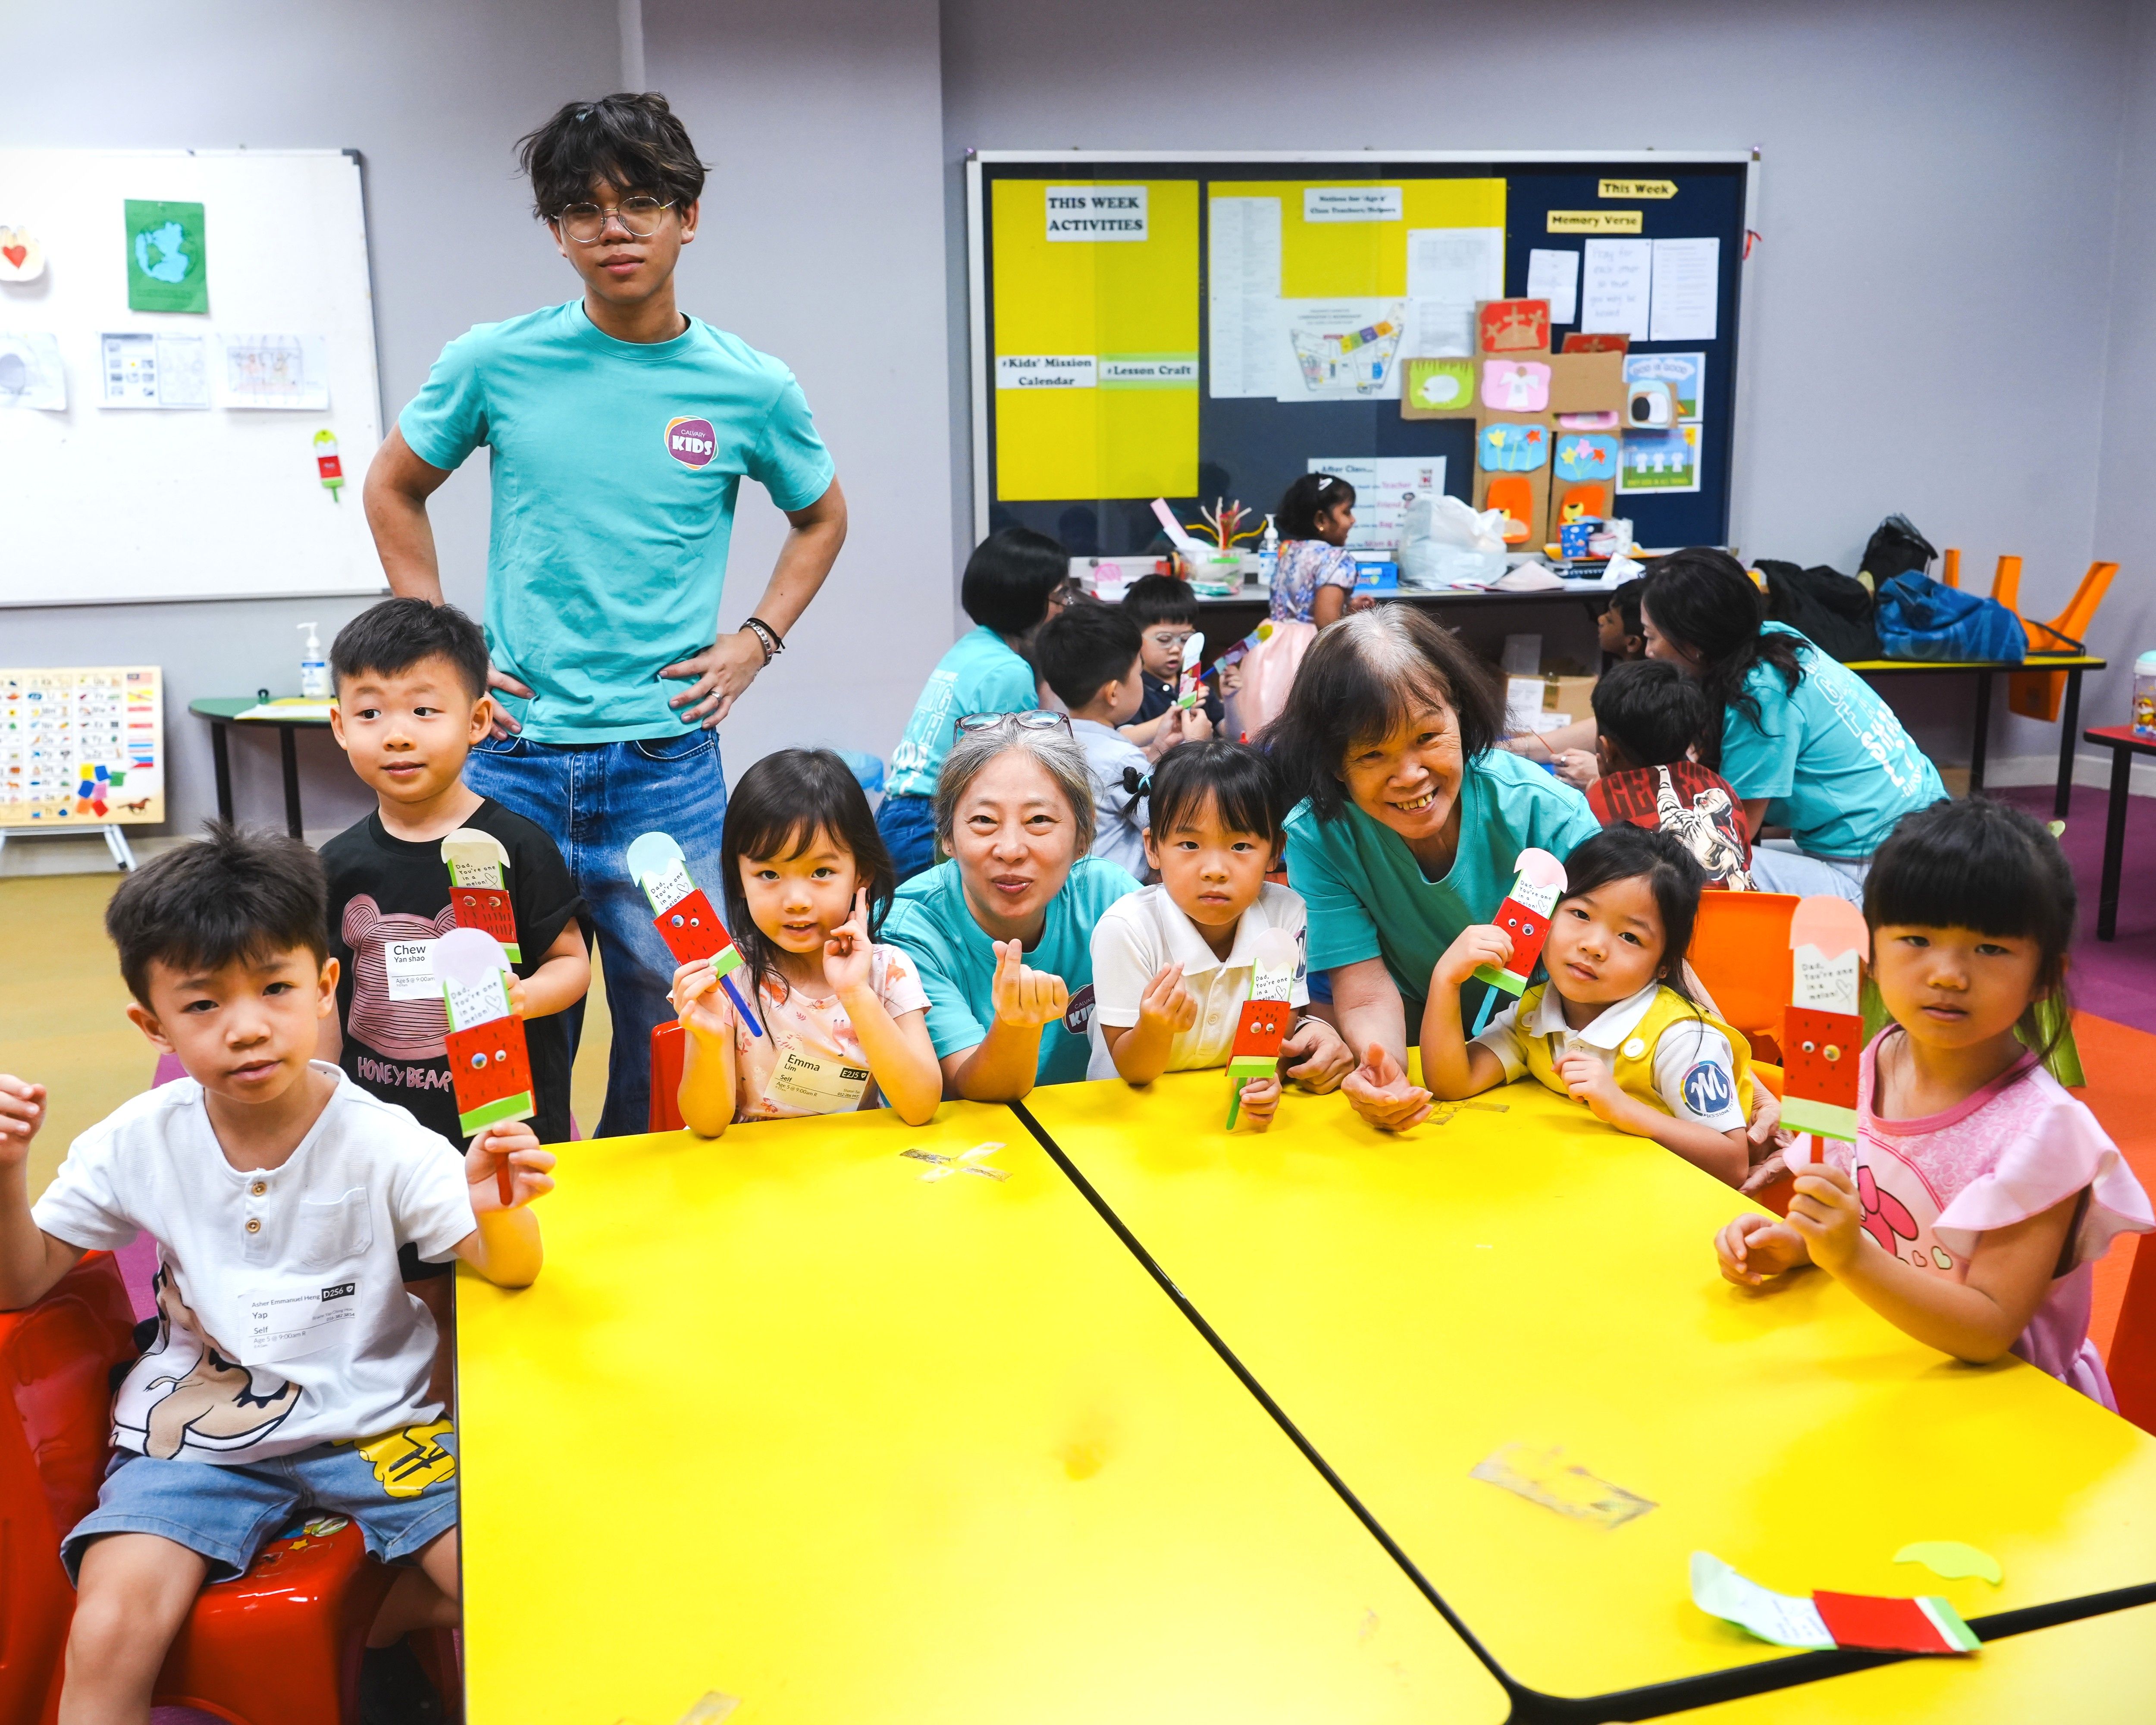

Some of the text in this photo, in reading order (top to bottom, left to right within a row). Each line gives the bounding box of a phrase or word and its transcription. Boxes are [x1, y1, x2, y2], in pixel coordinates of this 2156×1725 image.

[1603, 184, 1669, 194] This Week
[1048, 197, 1140, 209] THIS WEEK
[1048, 219, 1143, 231] ACTIVITIES
[1553, 216, 1636, 227] Memory Verse
[1045, 358, 1091, 367] Mission
[1159, 366, 1191, 375] Craft
[1018, 377, 1074, 386] Calendar
[681, 430, 705, 438] CALVARY
[673, 435, 712, 455] KIDS
[655, 872, 683, 899] You're one
[665, 892, 683, 910] melon!
[394, 945, 426, 955] Chew
[483, 982, 497, 992] one
[784, 1063, 796, 1072] Lim
[787, 1054, 820, 1071] Emma
[842, 1070, 860, 1079] E2J5
[796, 1087, 813, 1096] 9:00am
[271, 1296, 303, 1305] Emmanuel
